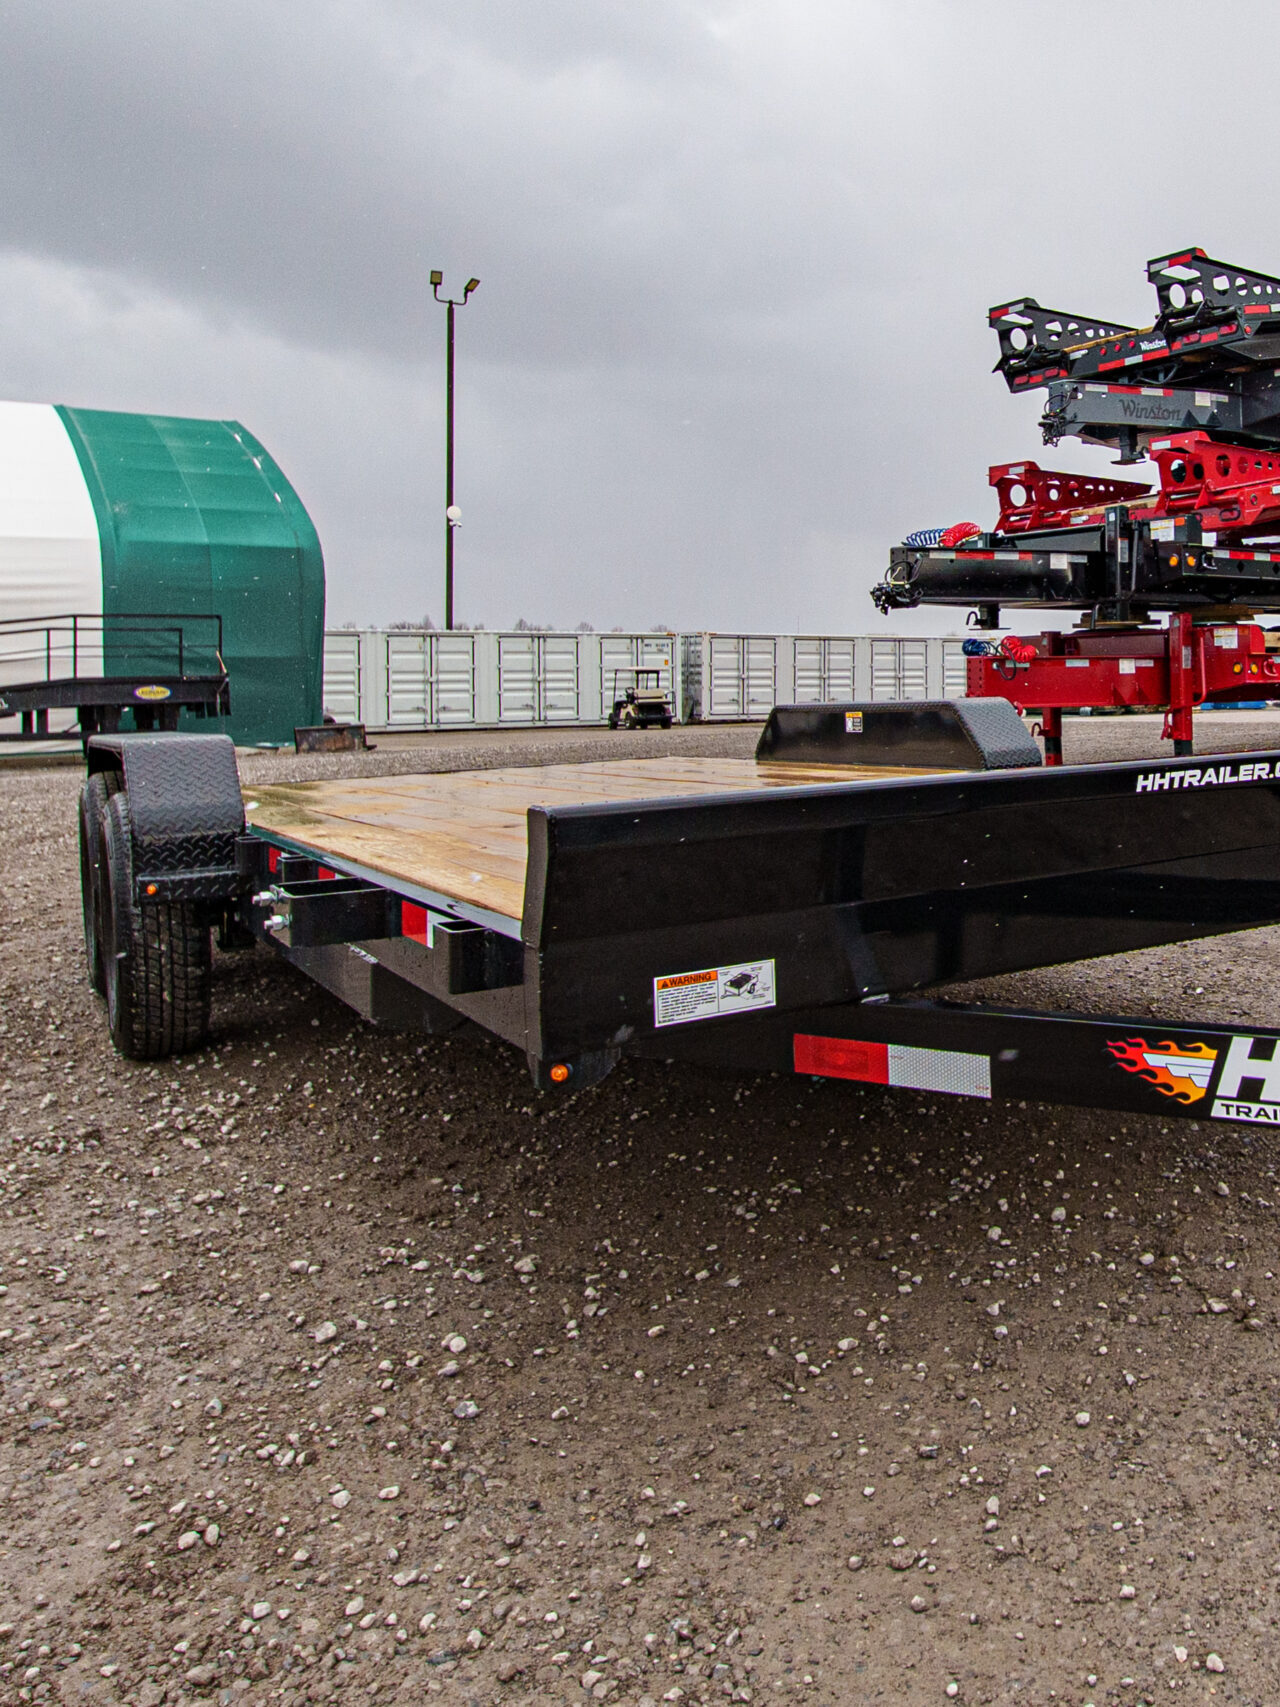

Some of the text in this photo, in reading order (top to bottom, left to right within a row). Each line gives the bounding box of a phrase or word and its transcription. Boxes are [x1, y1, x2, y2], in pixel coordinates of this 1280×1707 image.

[1139, 339, 1167, 351] Winston
[1119, 399, 1182, 421] Winston
[669, 972, 712, 987] WARNING
